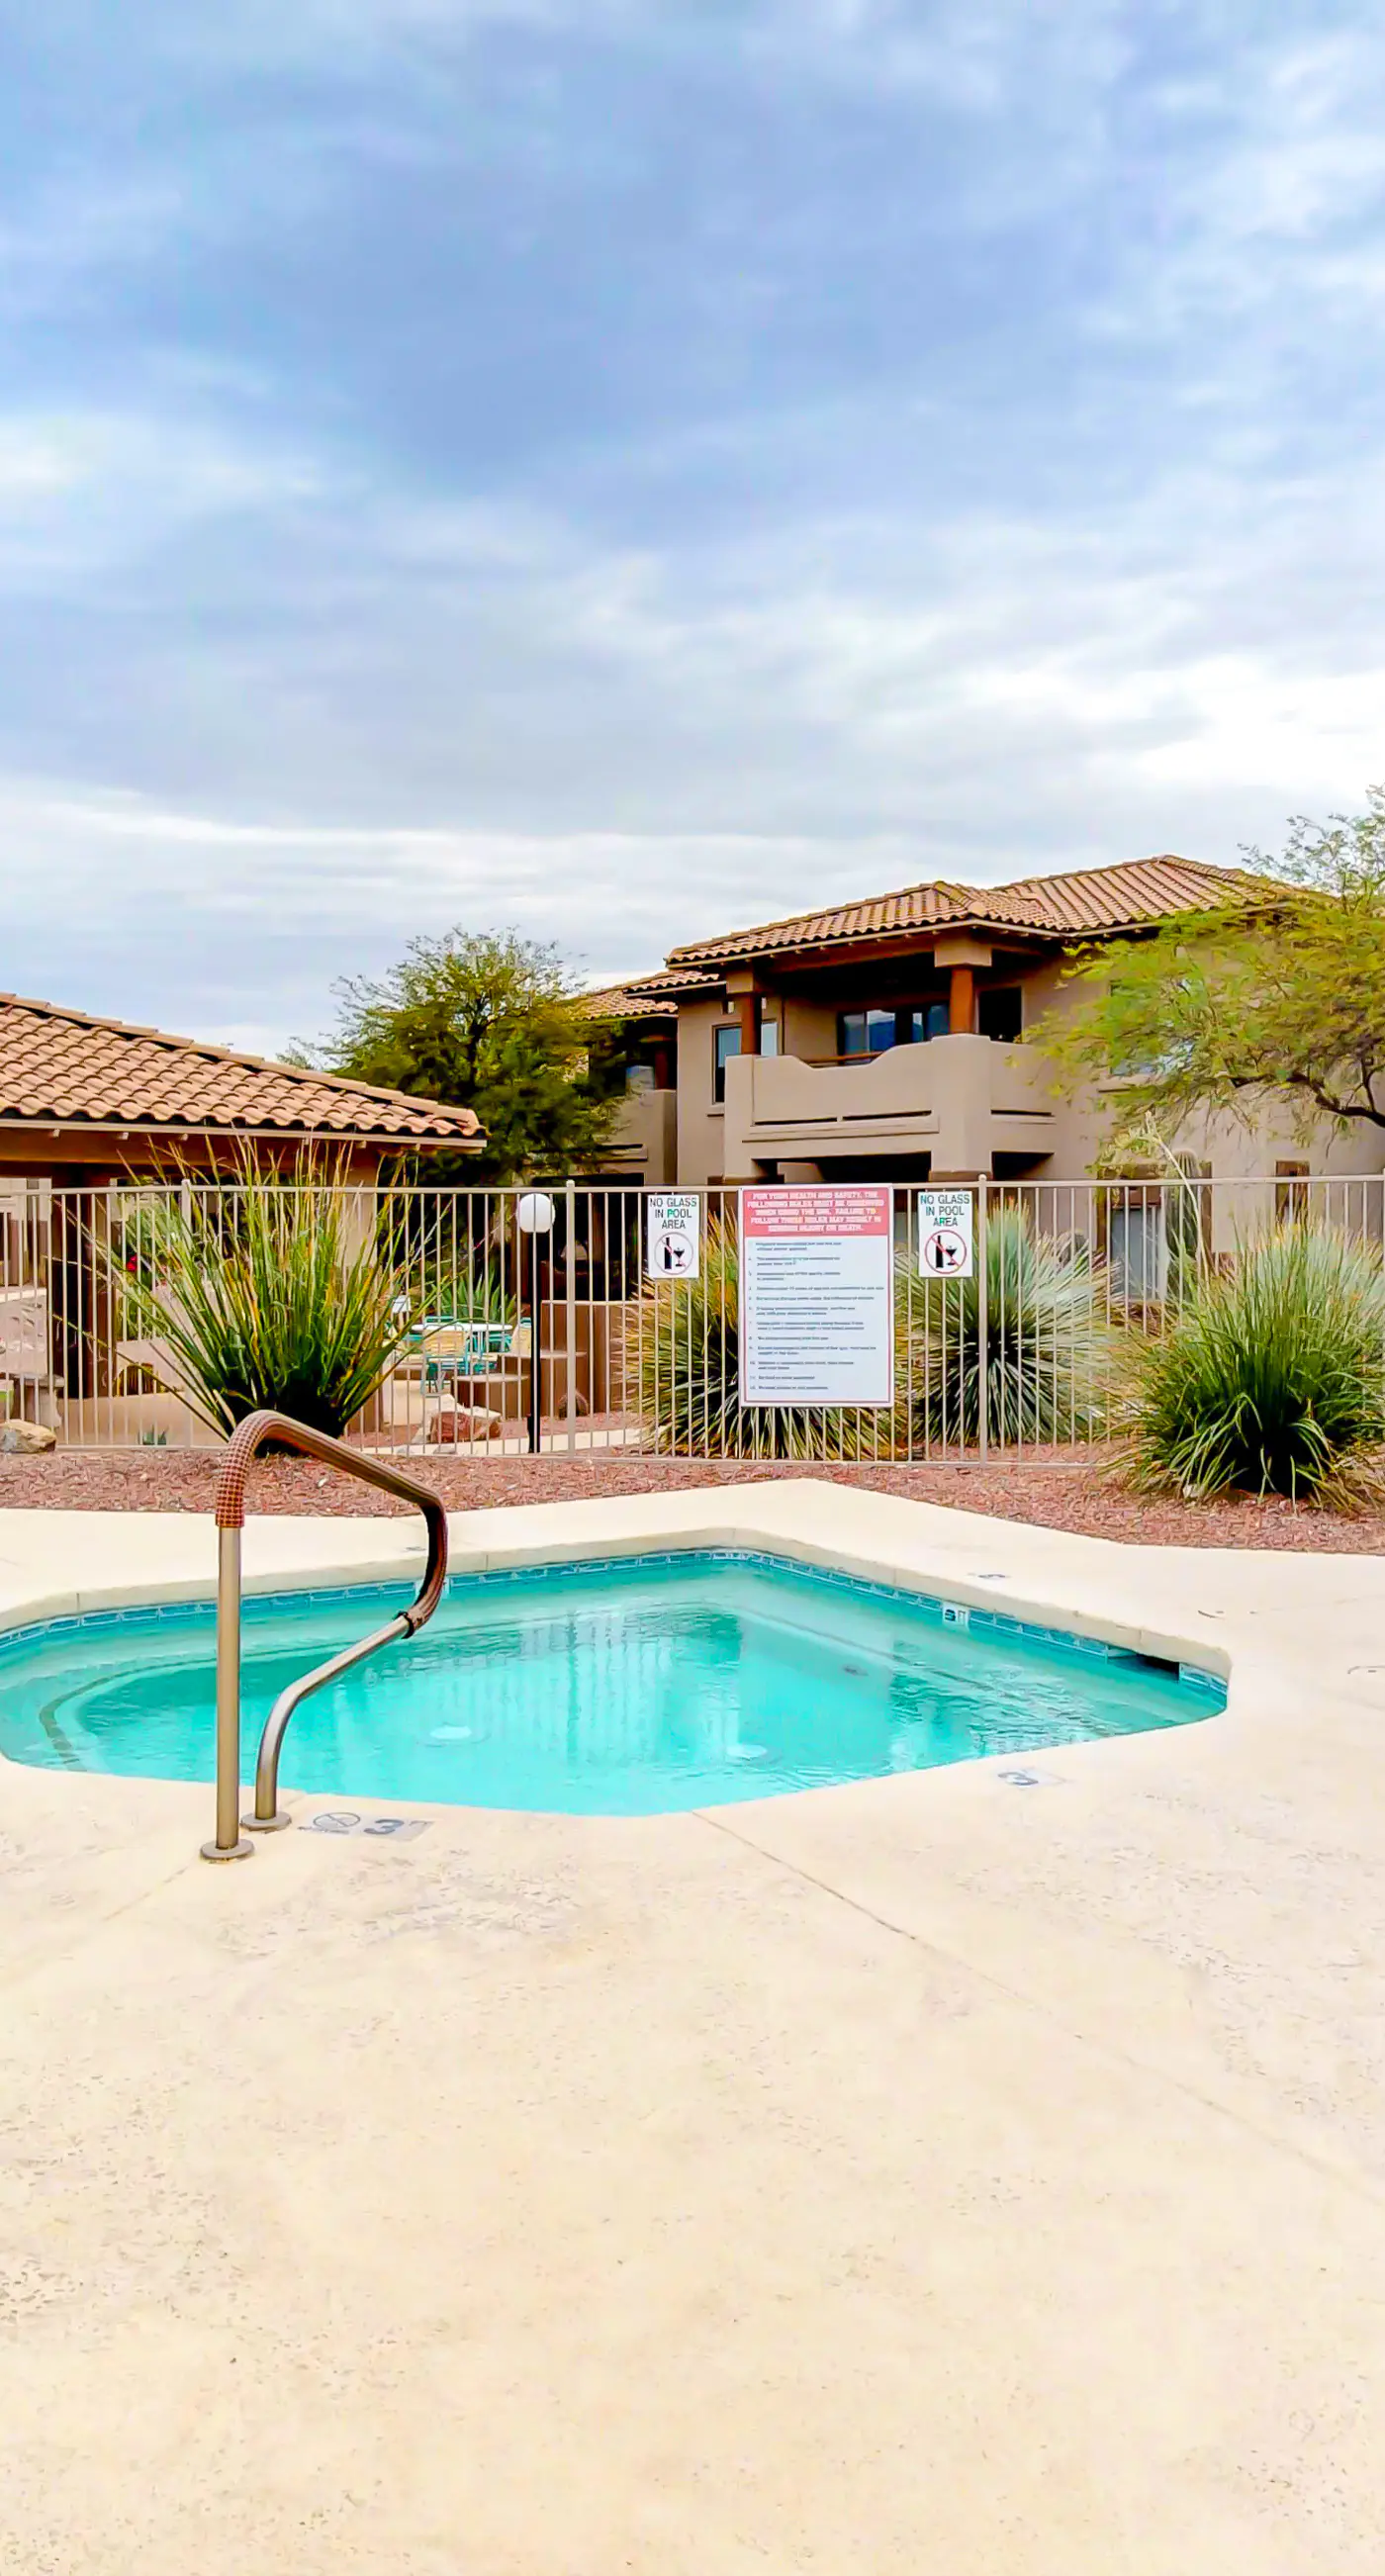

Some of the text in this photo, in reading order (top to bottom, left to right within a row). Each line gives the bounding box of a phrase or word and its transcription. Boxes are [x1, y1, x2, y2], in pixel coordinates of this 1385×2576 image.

[650, 1197, 697, 1208] NO GLASS
[920, 1193, 970, 1205] NO GLASS
[654, 1208, 692, 1218] IN POOL
[925, 1205, 966, 1216] IN POOL
[661, 1219, 686, 1230] AREA
[933, 1217, 959, 1227] AREA
[363, 1818, 405, 1835] 3
